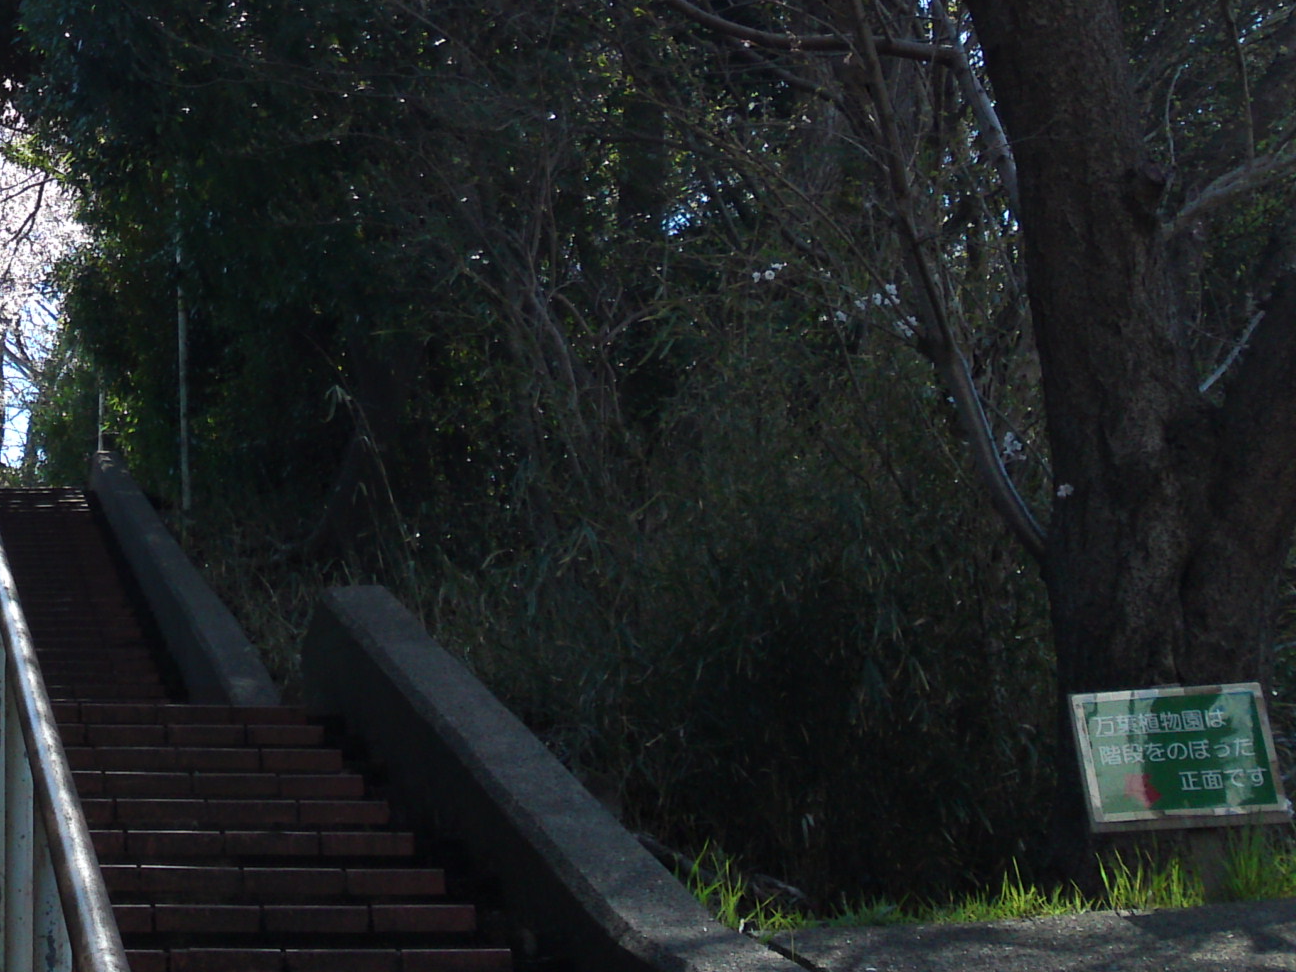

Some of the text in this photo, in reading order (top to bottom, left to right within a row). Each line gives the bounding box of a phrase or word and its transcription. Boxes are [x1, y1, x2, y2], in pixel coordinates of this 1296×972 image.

[1095, 709, 1226, 735] 万葉植物園は
[1100, 739, 1255, 765] 階段をのぼった
[1180, 767, 1267, 791] 正面です
